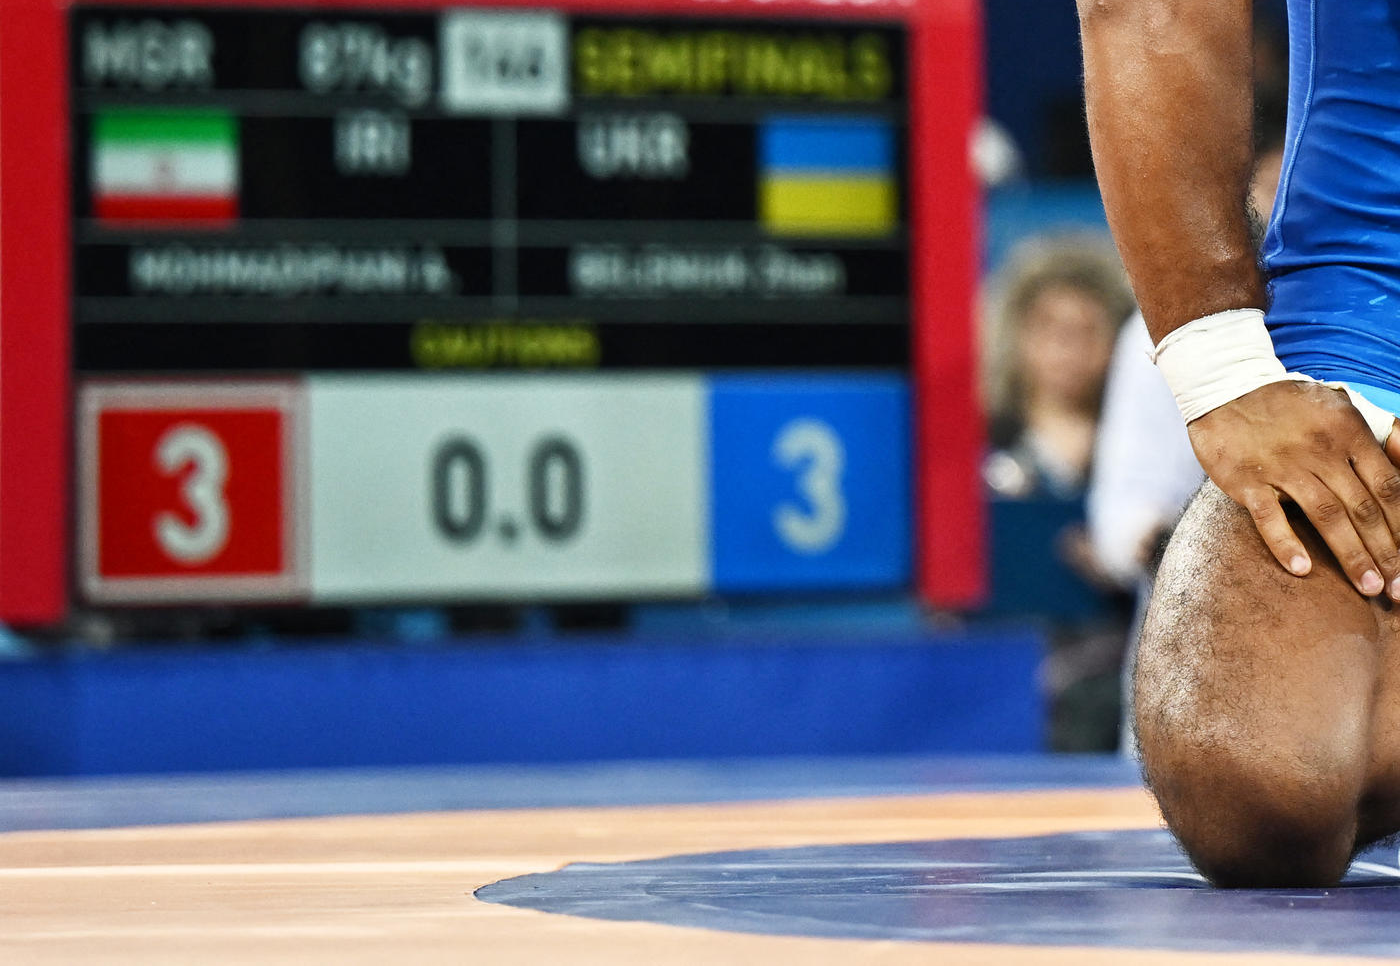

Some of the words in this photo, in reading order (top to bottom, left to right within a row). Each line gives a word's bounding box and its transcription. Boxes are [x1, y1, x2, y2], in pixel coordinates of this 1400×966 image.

[577, 32, 888, 97] SEMIFINALS
[337, 114, 410, 172] IRI
[580, 116, 688, 175] UKR
[411, 321, 598, 367] CAUTIONS
[152, 422, 231, 566] 3
[428, 429, 588, 547] 0.0
[770, 413, 848, 556] 3
